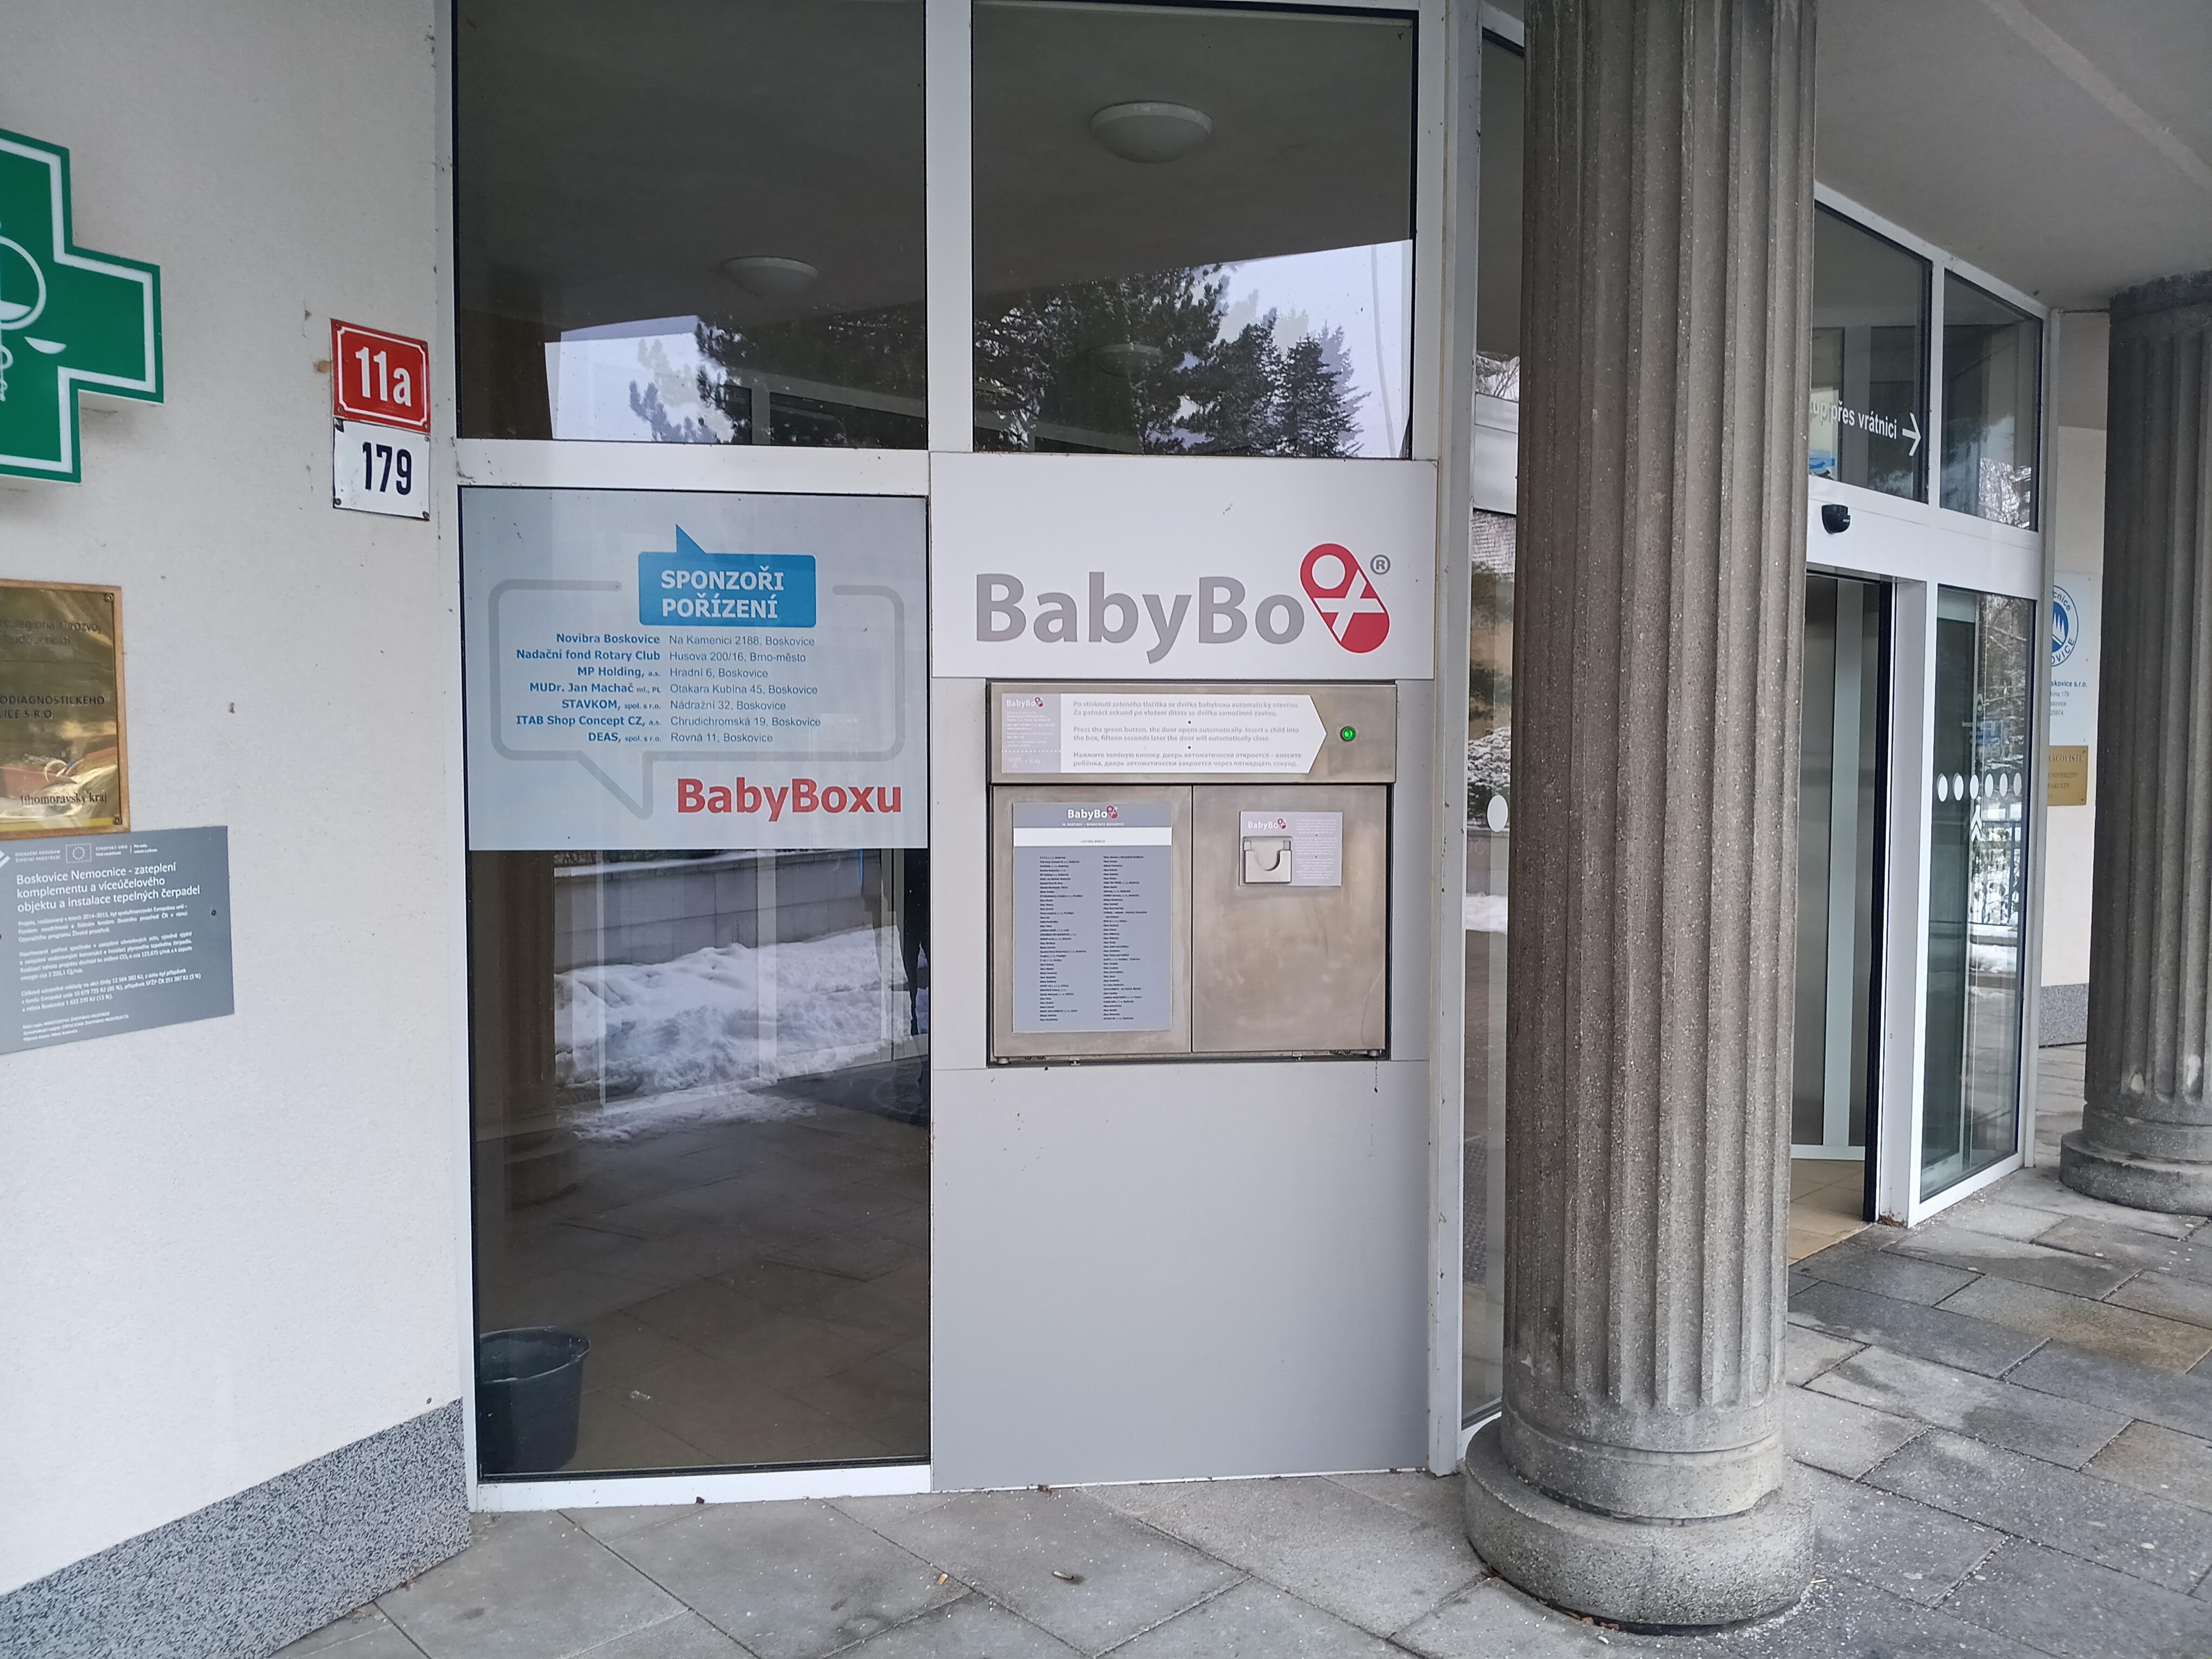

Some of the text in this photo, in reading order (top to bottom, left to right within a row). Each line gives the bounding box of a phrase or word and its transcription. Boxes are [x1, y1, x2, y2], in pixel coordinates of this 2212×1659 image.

[355, 346, 411, 407] 11a
[1831, 400, 1855, 426] přes
[1858, 410, 1897, 440] vrátnici
[362, 441, 412, 495] 179
[661, 565, 784, 591] SPONZOŘI
[662, 592, 778, 618] POŘÍZENÍ
[556, 633, 660, 644] Novibra Boskovice
[670, 635, 684, 644] Na
[687, 635, 732, 645] Kamenici
[765, 636, 815, 646] Boskovice
[517, 649, 660, 662] Nadační fond Rotary Club
[670, 652, 806, 662] Husova 200/16, Brno-město
[577, 667, 594, 676] MP
[598, 667, 644, 679] Holding,
[670, 668, 703, 677] Hradní
[719, 668, 768, 677] Boskovice
[530, 682, 565, 692] MUDr.
[568, 683, 587, 692] Jan
[591, 682, 634, 692] Machač
[670, 684, 709, 693] Otakara
[750, 685, 765, 695] 45,
[769, 685, 817, 694] Boskovice
[562, 700, 620, 710] STAVKOM,
[670, 700, 786, 711] Nádražní 32, Boskovice
[517, 716, 544, 725] ITAB
[547, 716, 576, 727] Shop
[579, 716, 624, 727] Concept
[628, 717, 645, 727] CZ,
[671, 716, 821, 727] Chrudichromská 19, Boskovice
[588, 732, 621, 743] DEAS,
[671, 733, 773, 743] Rovná 11, Boskovice
[677, 778, 902, 822] BabyBoxu
[17, 873, 68, 885] Boskovice
[71, 867, 126, 880] Nemocnice
[134, 862, 176, 875] zateplení
[17, 884, 87, 899] komplementu
[98, 877, 165, 891] víceúčelového
[18, 900, 56, 914] objektu
[68, 895, 111, 907] instalace
[113, 890, 159, 904] tepelných
[161, 885, 200, 899] čerpadel
